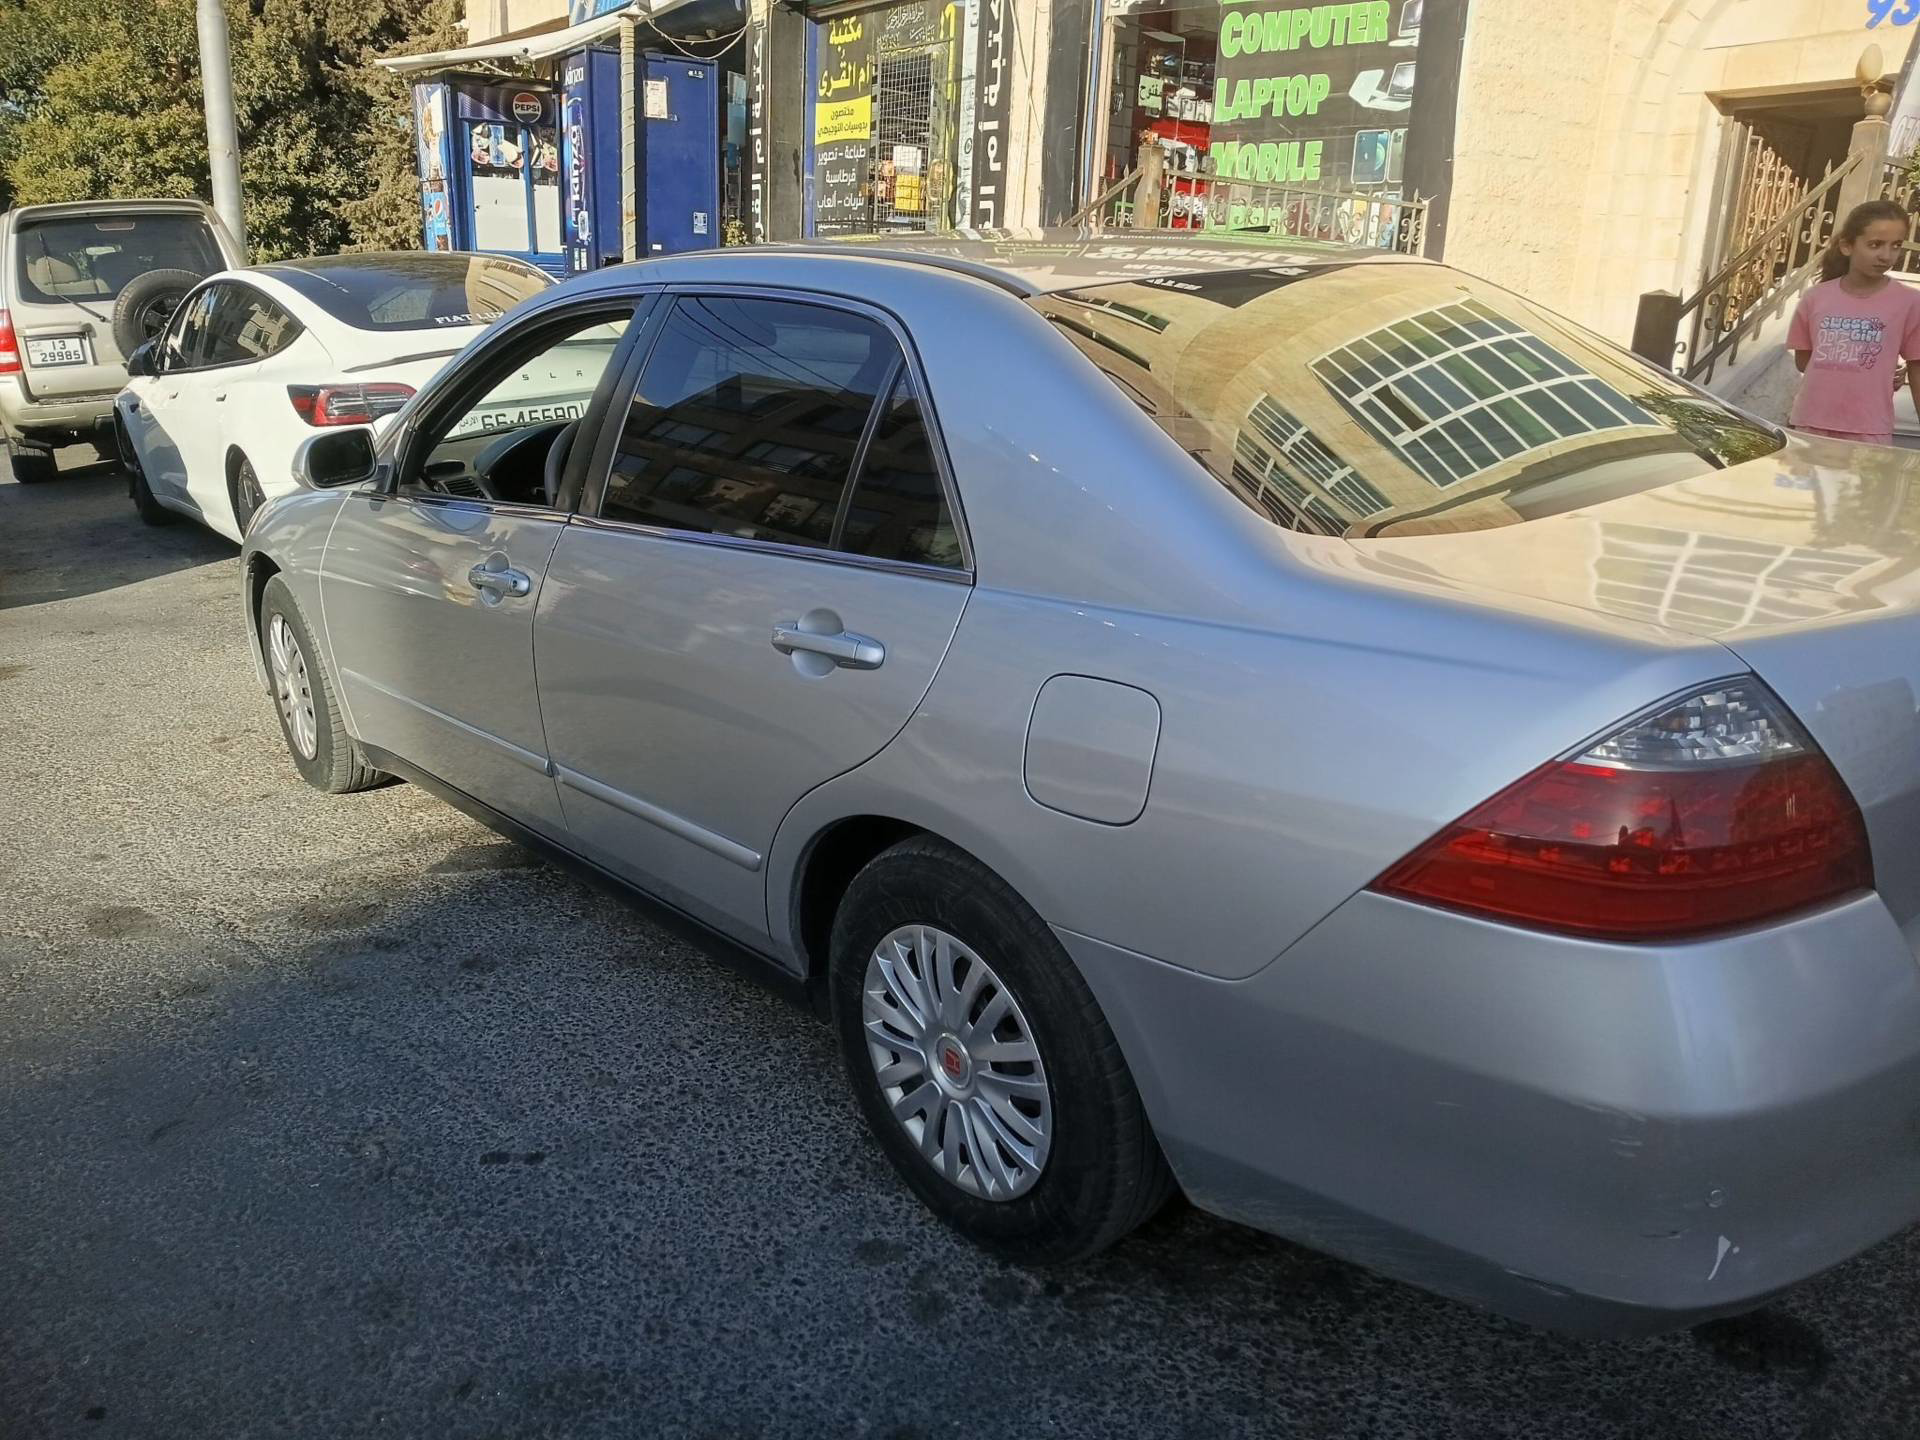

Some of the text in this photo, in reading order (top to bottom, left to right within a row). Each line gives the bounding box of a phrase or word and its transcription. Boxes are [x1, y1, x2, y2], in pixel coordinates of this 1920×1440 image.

[829, 16, 862, 52] مكتبة
[1221, 1, 1390, 58] COMPUTER
[984, 0, 1005, 106] كتبة
[752, 31, 764, 118] كتبة
[858, 54, 870, 93] أم
[515, 103, 540, 113] PEPSI
[1214, 73, 1330, 122] LAPTOP
[817, 144, 866, 165] طباعة تصوير
[1210, 141, 1323, 182] MOBILE
[826, 168, 856, 187] قرطاسية
[434, 314, 472, 324] FIAT
[40, 350, 80, 362] 29985
[52, 340, 66, 350] 13
